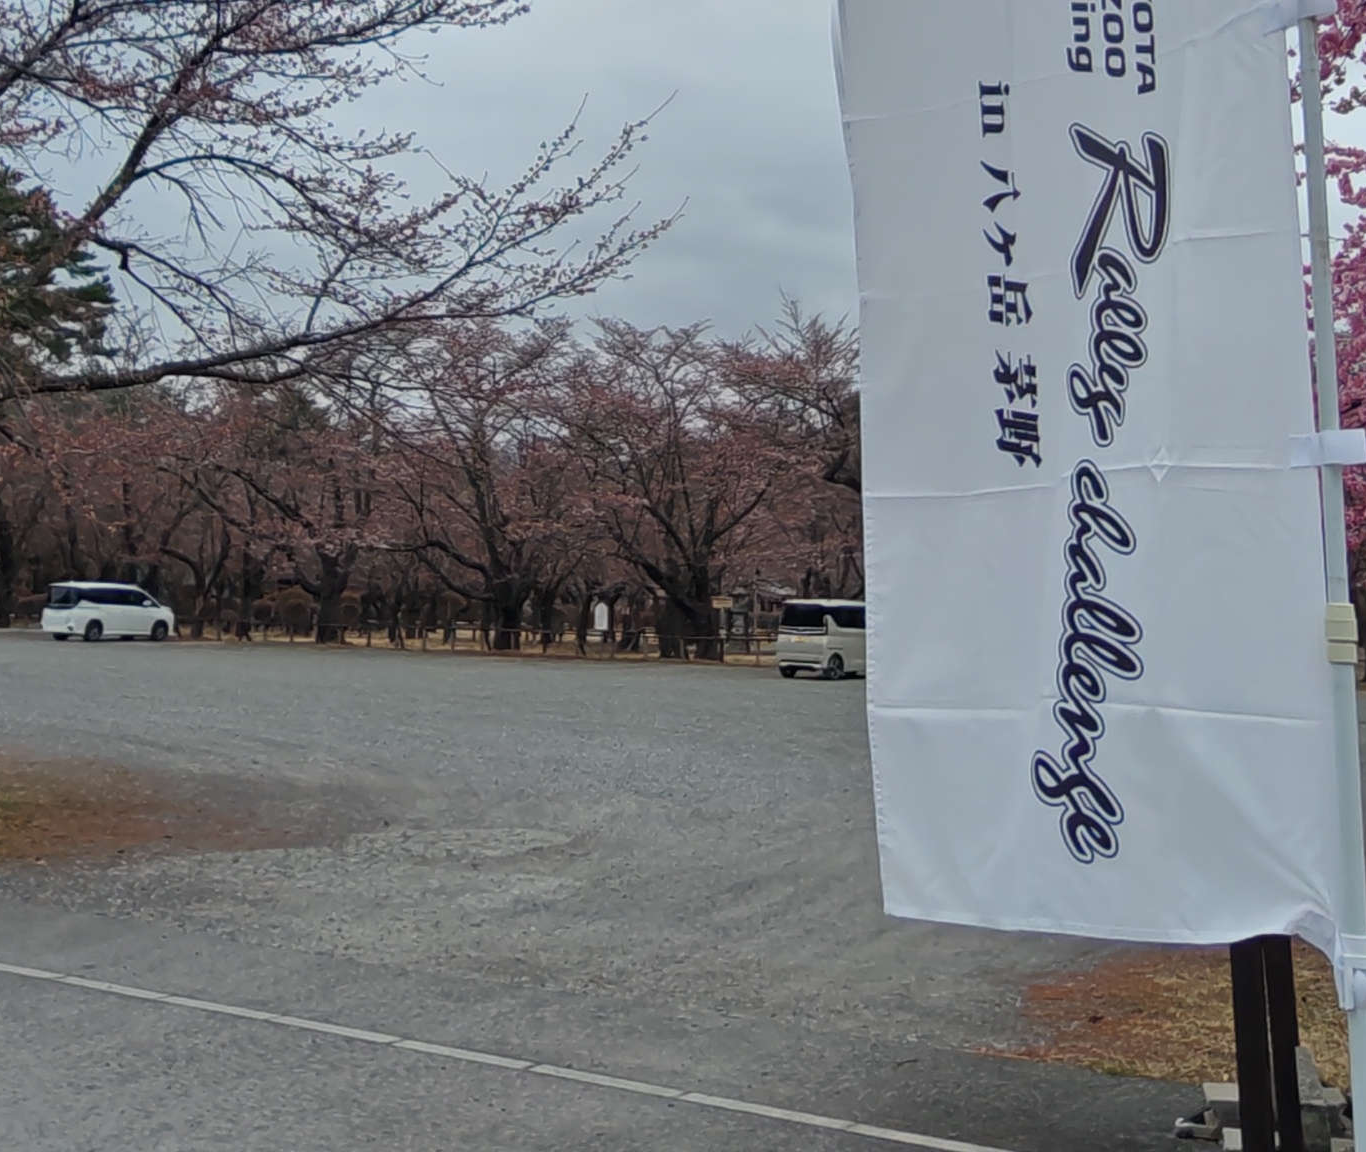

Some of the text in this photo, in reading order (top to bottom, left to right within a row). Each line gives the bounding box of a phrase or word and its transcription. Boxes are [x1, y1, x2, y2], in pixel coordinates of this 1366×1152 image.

[978, 79, 1011, 139] in
[1069, 122, 1171, 448] Rally
[994, 349, 1043, 469] 茅野
